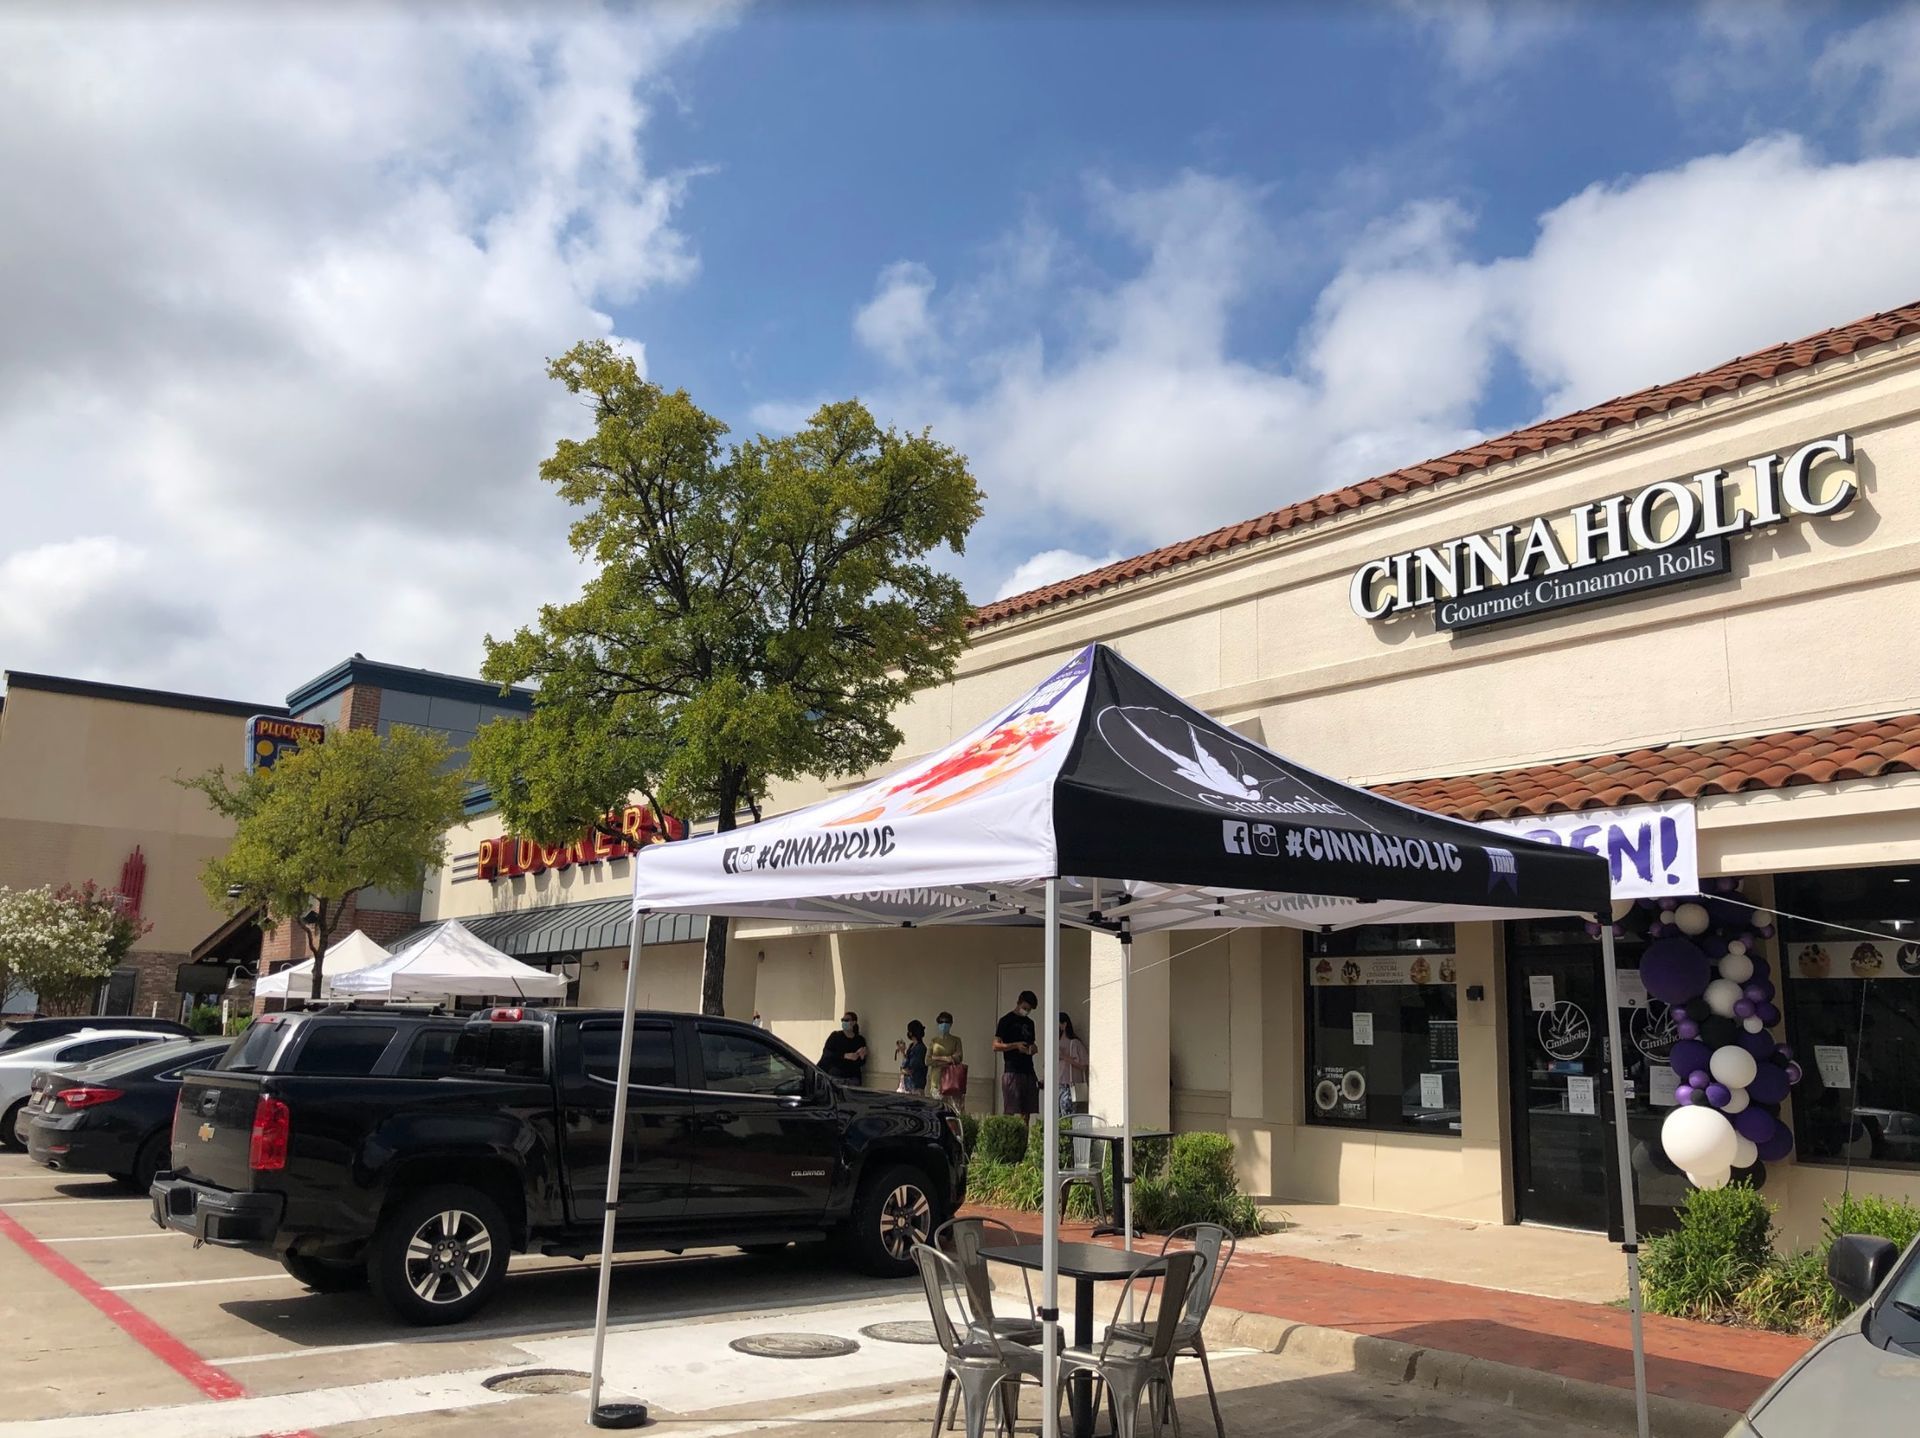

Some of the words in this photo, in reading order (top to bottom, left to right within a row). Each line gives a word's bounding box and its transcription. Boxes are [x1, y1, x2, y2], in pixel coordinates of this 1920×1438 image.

[1349, 433, 1856, 619] CINNAHOLIC
[1441, 588, 1532, 625] Gourmet
[1535, 562, 1654, 604] Cinnamon
[1657, 544, 1716, 577] Rolls
[257, 720, 322, 742] PLUCKERS
[756, 824, 897, 870] #CINNAHOLIC
[1285, 827, 1463, 873] #CINNAHOLIC
[1546, 1029, 1588, 1050] Cinnaholic
[1638, 1033, 1682, 1050] Cinnaho
